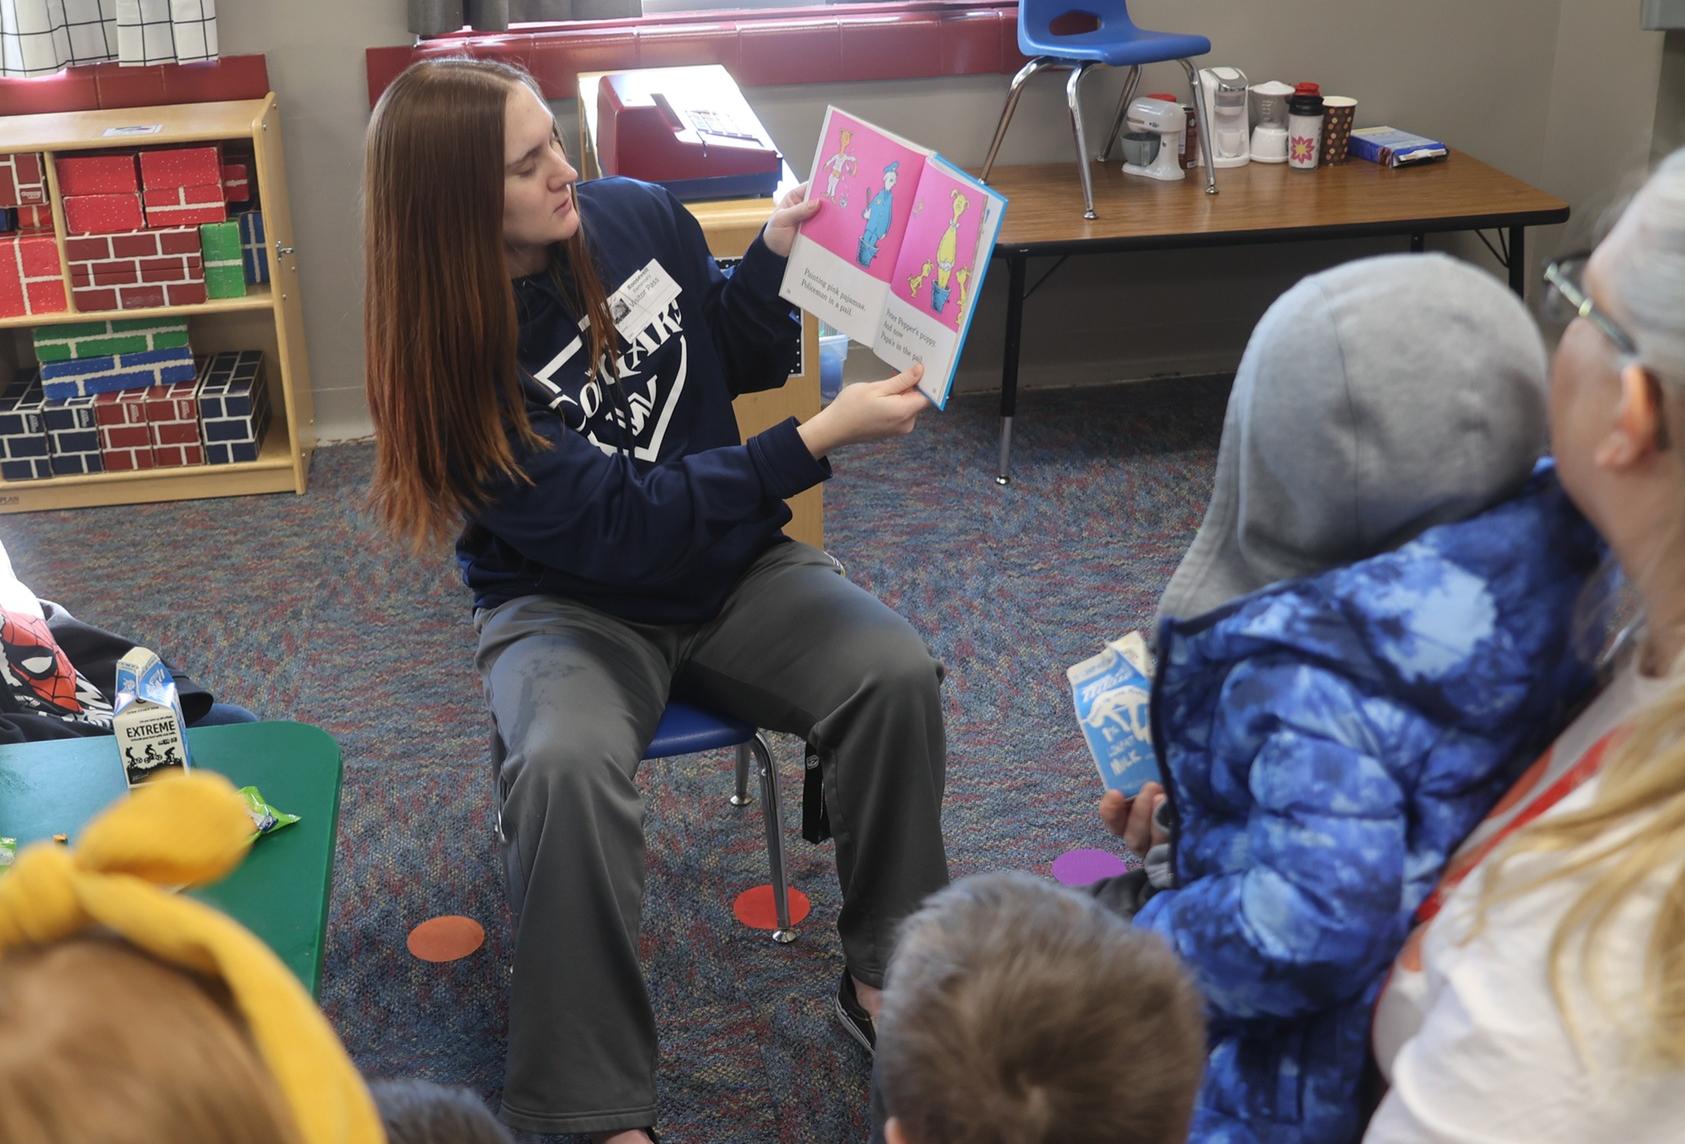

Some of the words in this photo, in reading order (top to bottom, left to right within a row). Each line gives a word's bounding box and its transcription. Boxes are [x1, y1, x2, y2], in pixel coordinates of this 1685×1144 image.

[628, 289, 647, 307] Visitor
[645, 276, 659, 291] Pass
[801, 278, 828, 301] Policeman
[804, 267, 827, 289] Painting
[826, 283, 839, 296] pink
[548, 299, 683, 432] COGAR
[126, 720, 176, 738] EXTREME
